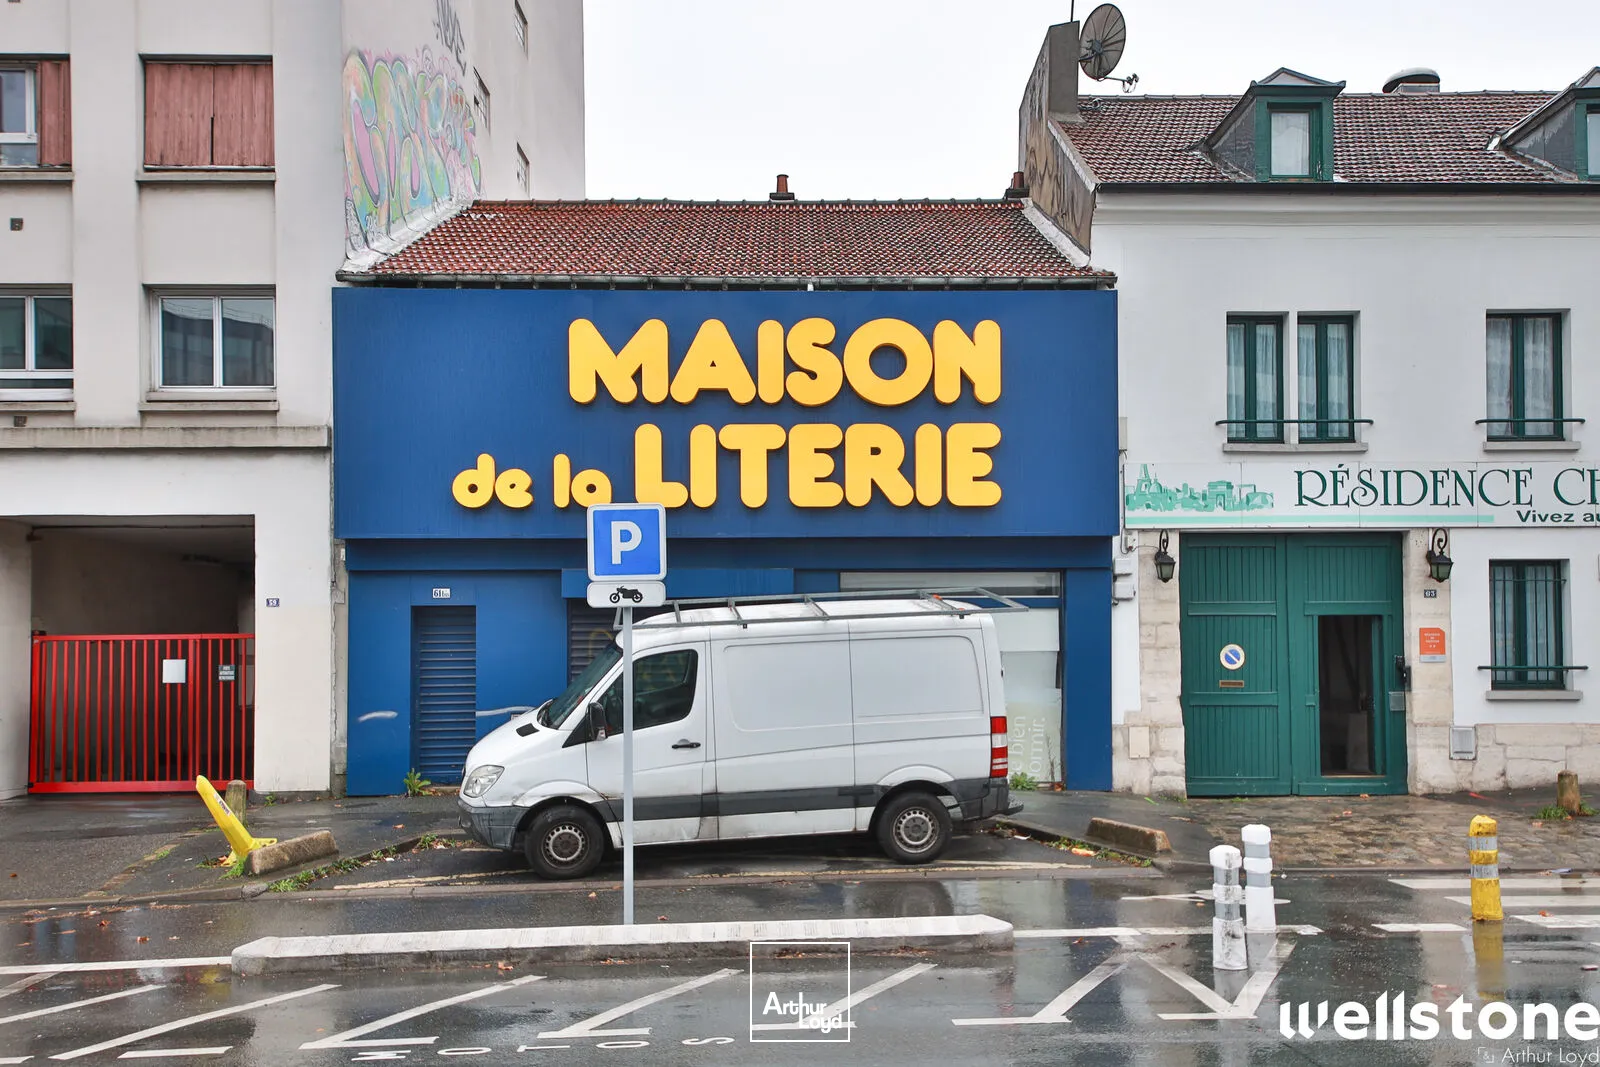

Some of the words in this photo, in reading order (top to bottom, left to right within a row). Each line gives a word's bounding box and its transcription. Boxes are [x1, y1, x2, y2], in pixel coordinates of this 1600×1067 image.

[568, 317, 1002, 406] MAISON
[451, 453, 534, 509] de
[553, 453, 612, 508] la
[634, 422, 1002, 509] LITERIE
[1294, 464, 1533, 508] RÉSIDENCE
[1516, 510, 1574, 523] Vivez
[611, 521, 642, 565] P
[1008, 715, 1026, 757] bien
[351, 1036, 736, 1061] MOTOS
